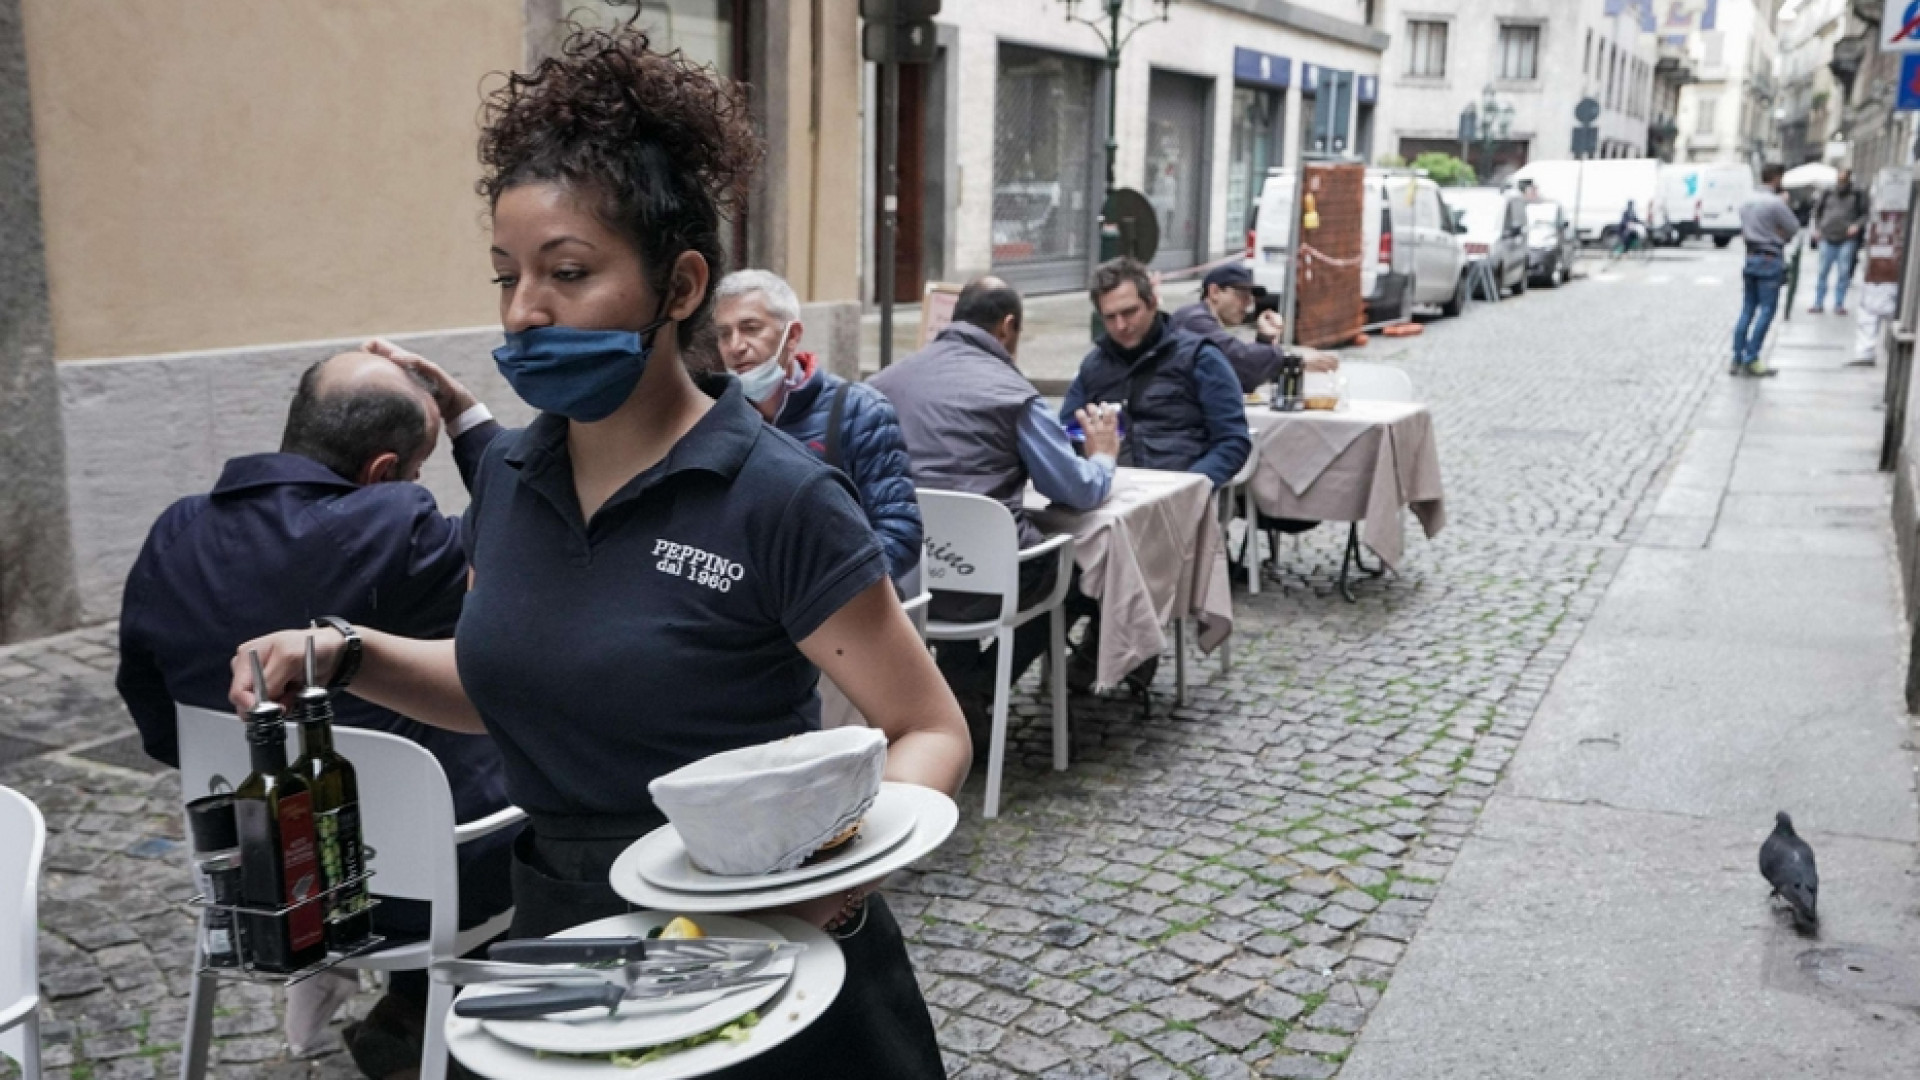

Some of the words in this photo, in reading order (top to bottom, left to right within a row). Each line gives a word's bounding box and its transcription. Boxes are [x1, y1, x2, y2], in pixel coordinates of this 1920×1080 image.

[652, 538, 745, 581] PEPPINO
[656, 557, 683, 576] dal
[687, 564, 732, 593] 1960
